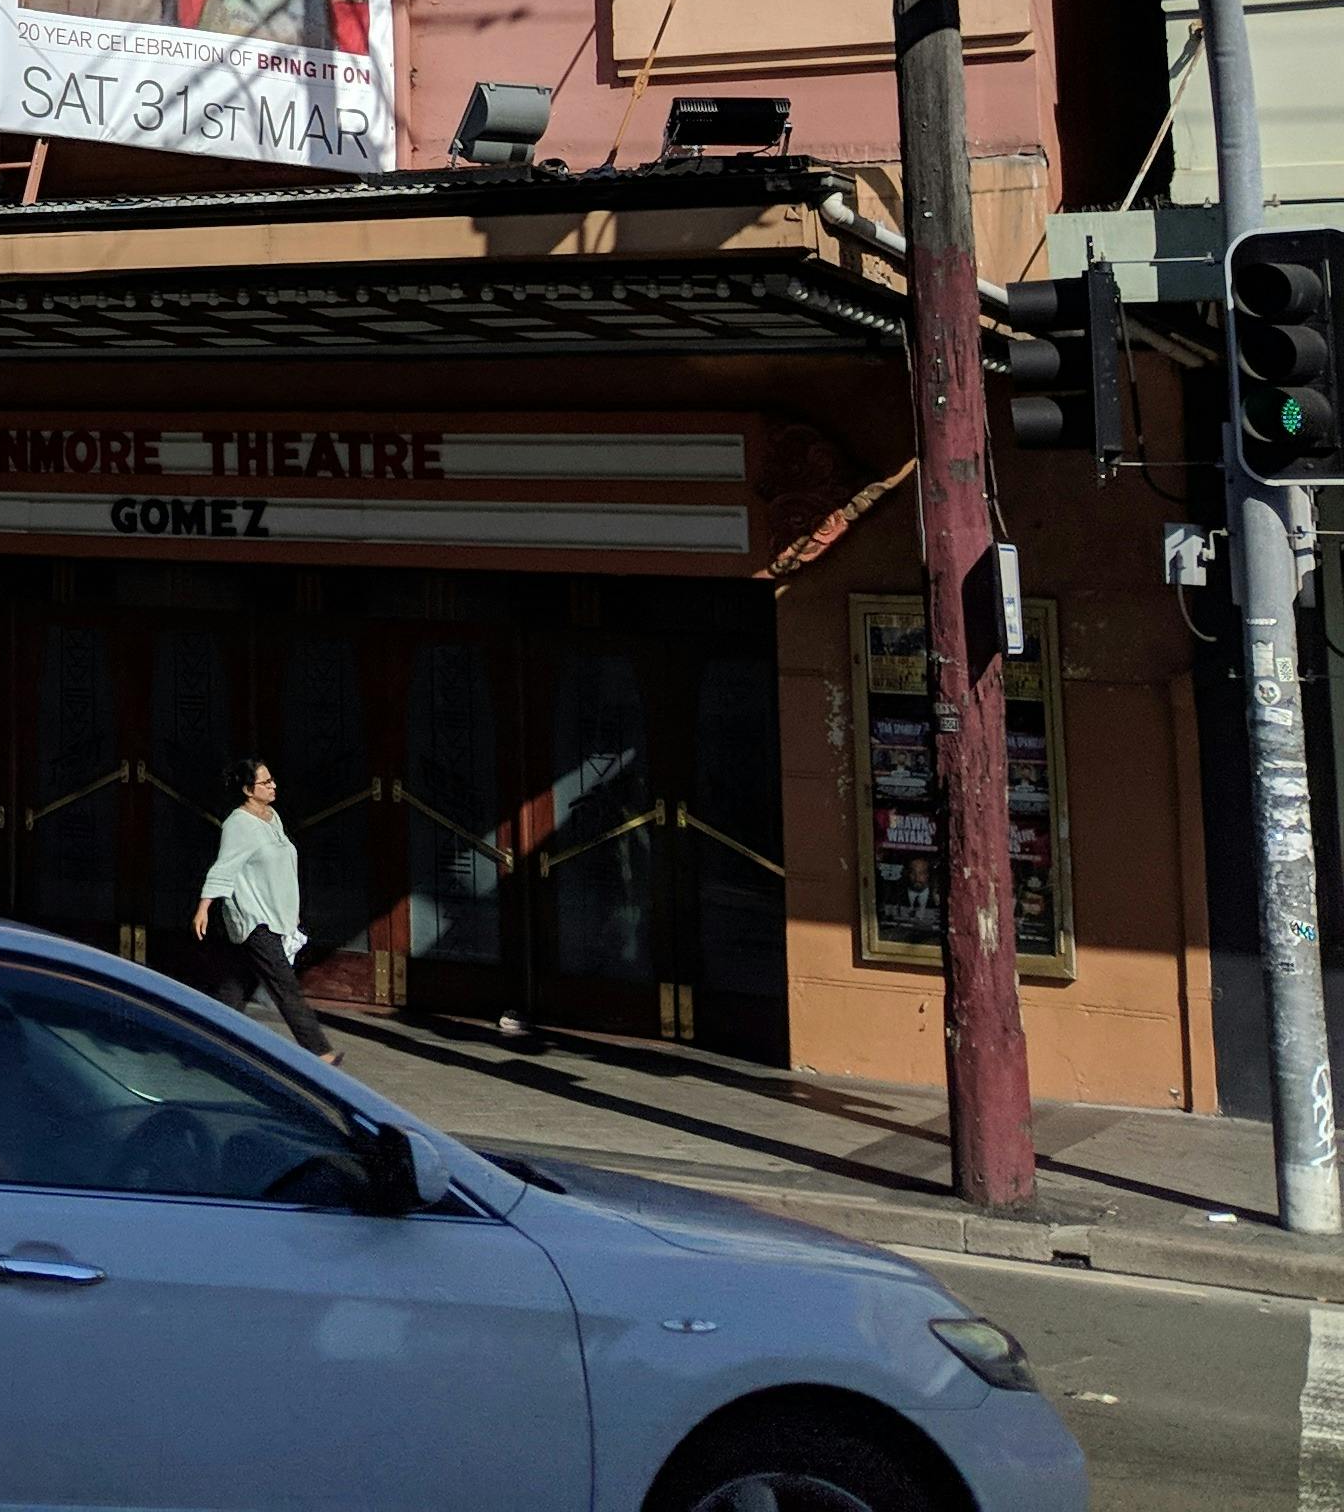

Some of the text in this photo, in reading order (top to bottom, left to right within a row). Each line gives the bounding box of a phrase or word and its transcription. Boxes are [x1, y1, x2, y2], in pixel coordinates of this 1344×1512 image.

[18, 21, 371, 85] 20 YEAR CELEBRATION OF BRING IT ON
[22, 66, 119, 126] SAT
[258, 95, 369, 160] MAR
[203, 430, 444, 478] THEATRE
[111, 498, 269, 538] GOMEZ
[886, 828, 932, 845] WAYANS
